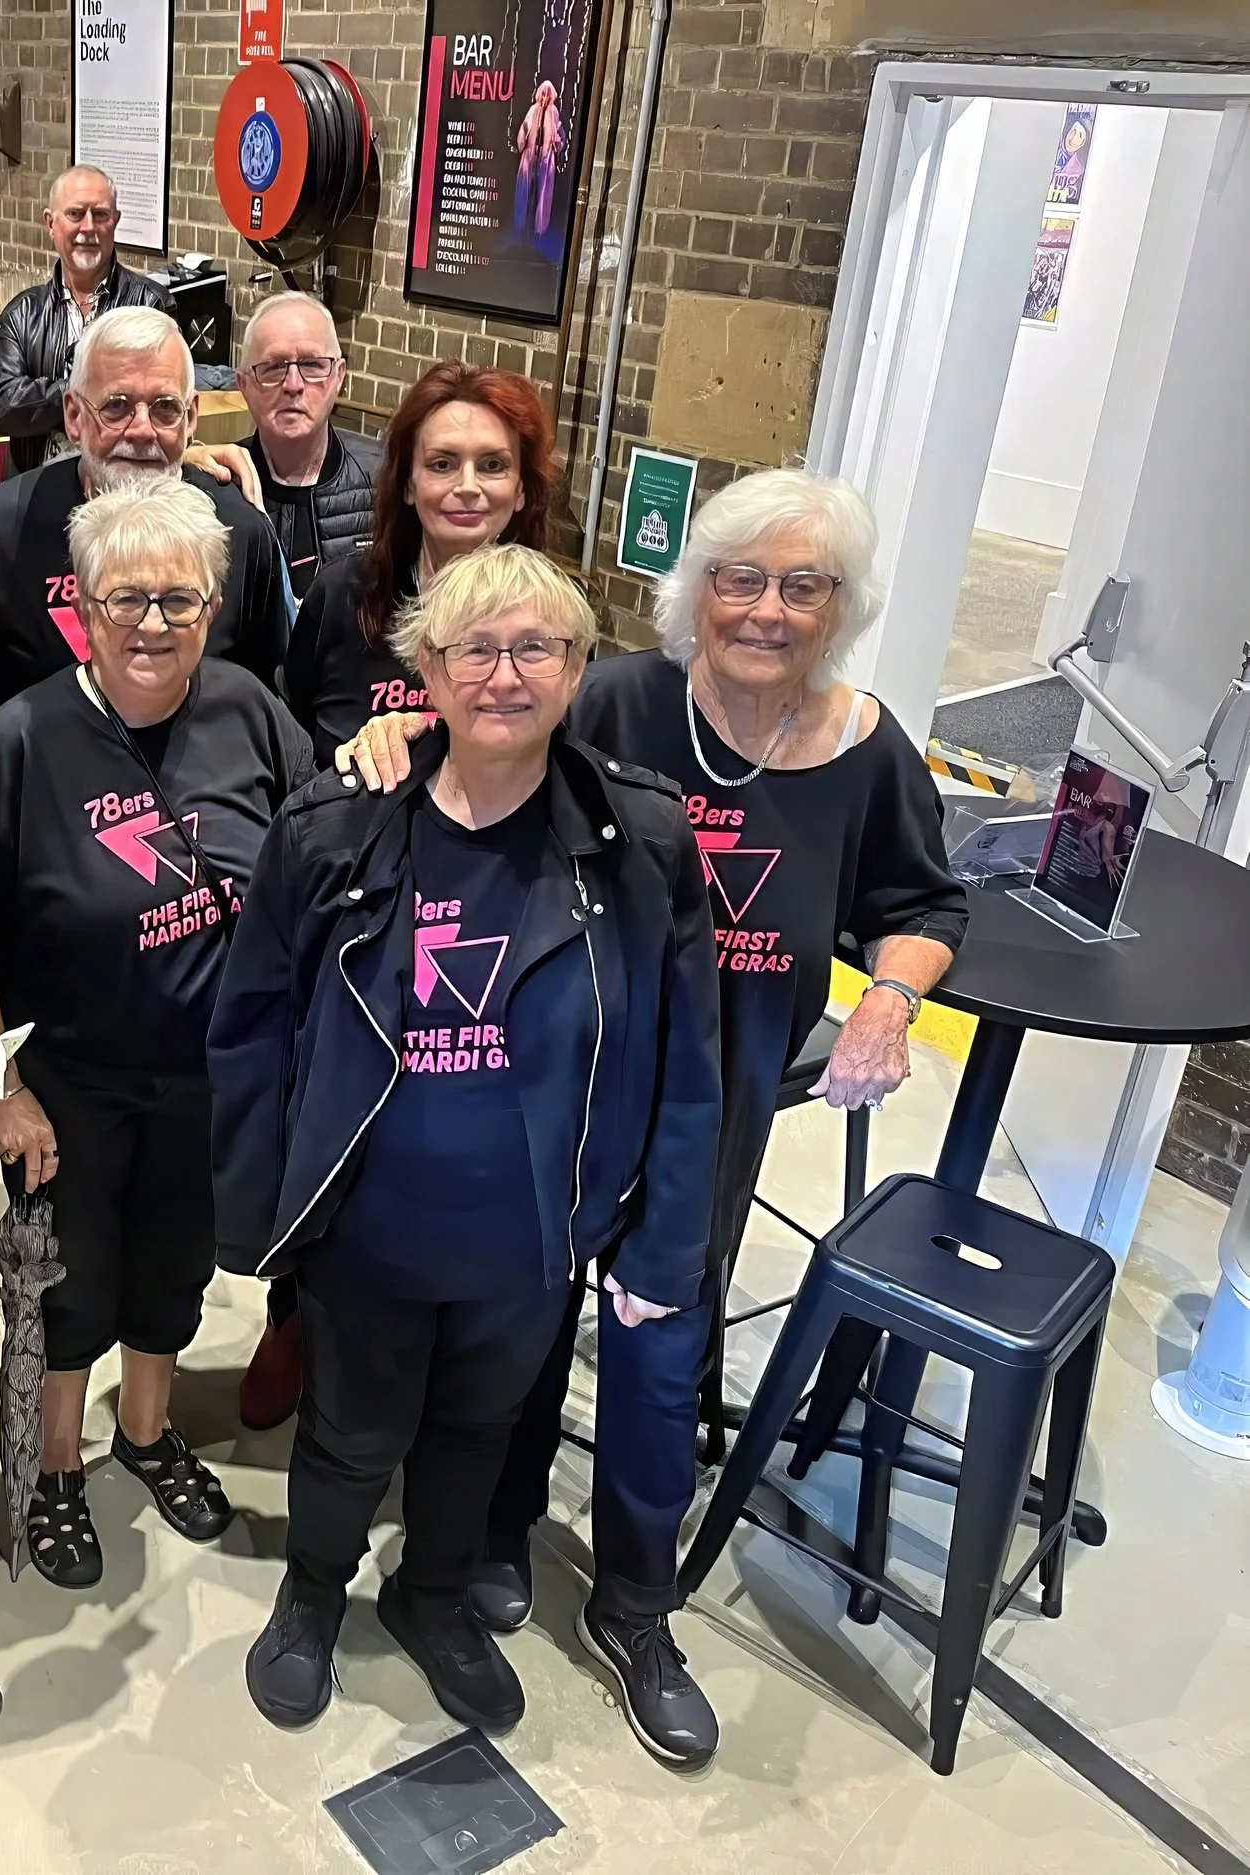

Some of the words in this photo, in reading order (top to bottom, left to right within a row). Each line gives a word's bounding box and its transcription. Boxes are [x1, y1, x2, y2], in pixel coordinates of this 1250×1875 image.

[81, 18, 126, 44] Loading
[81, 41, 110, 62] Dock
[453, 34, 493, 67] BAR
[450, 69, 514, 102] MENU
[370, 679, 430, 711] 78er
[83, 791, 155, 829] 78ers
[682, 795, 745, 826] 8ers
[1070, 787, 1092, 809] BAR
[139, 900, 178, 931] THE
[181, 877, 233, 916] FIRT
[139, 910, 201, 952] MARDI
[713, 928, 781, 951] FIRST
[730, 952, 794, 972] GRAS
[402, 1028, 452, 1049] THE
[457, 1024, 505, 1049] FIR
[401, 1049, 480, 1074] MARDI
